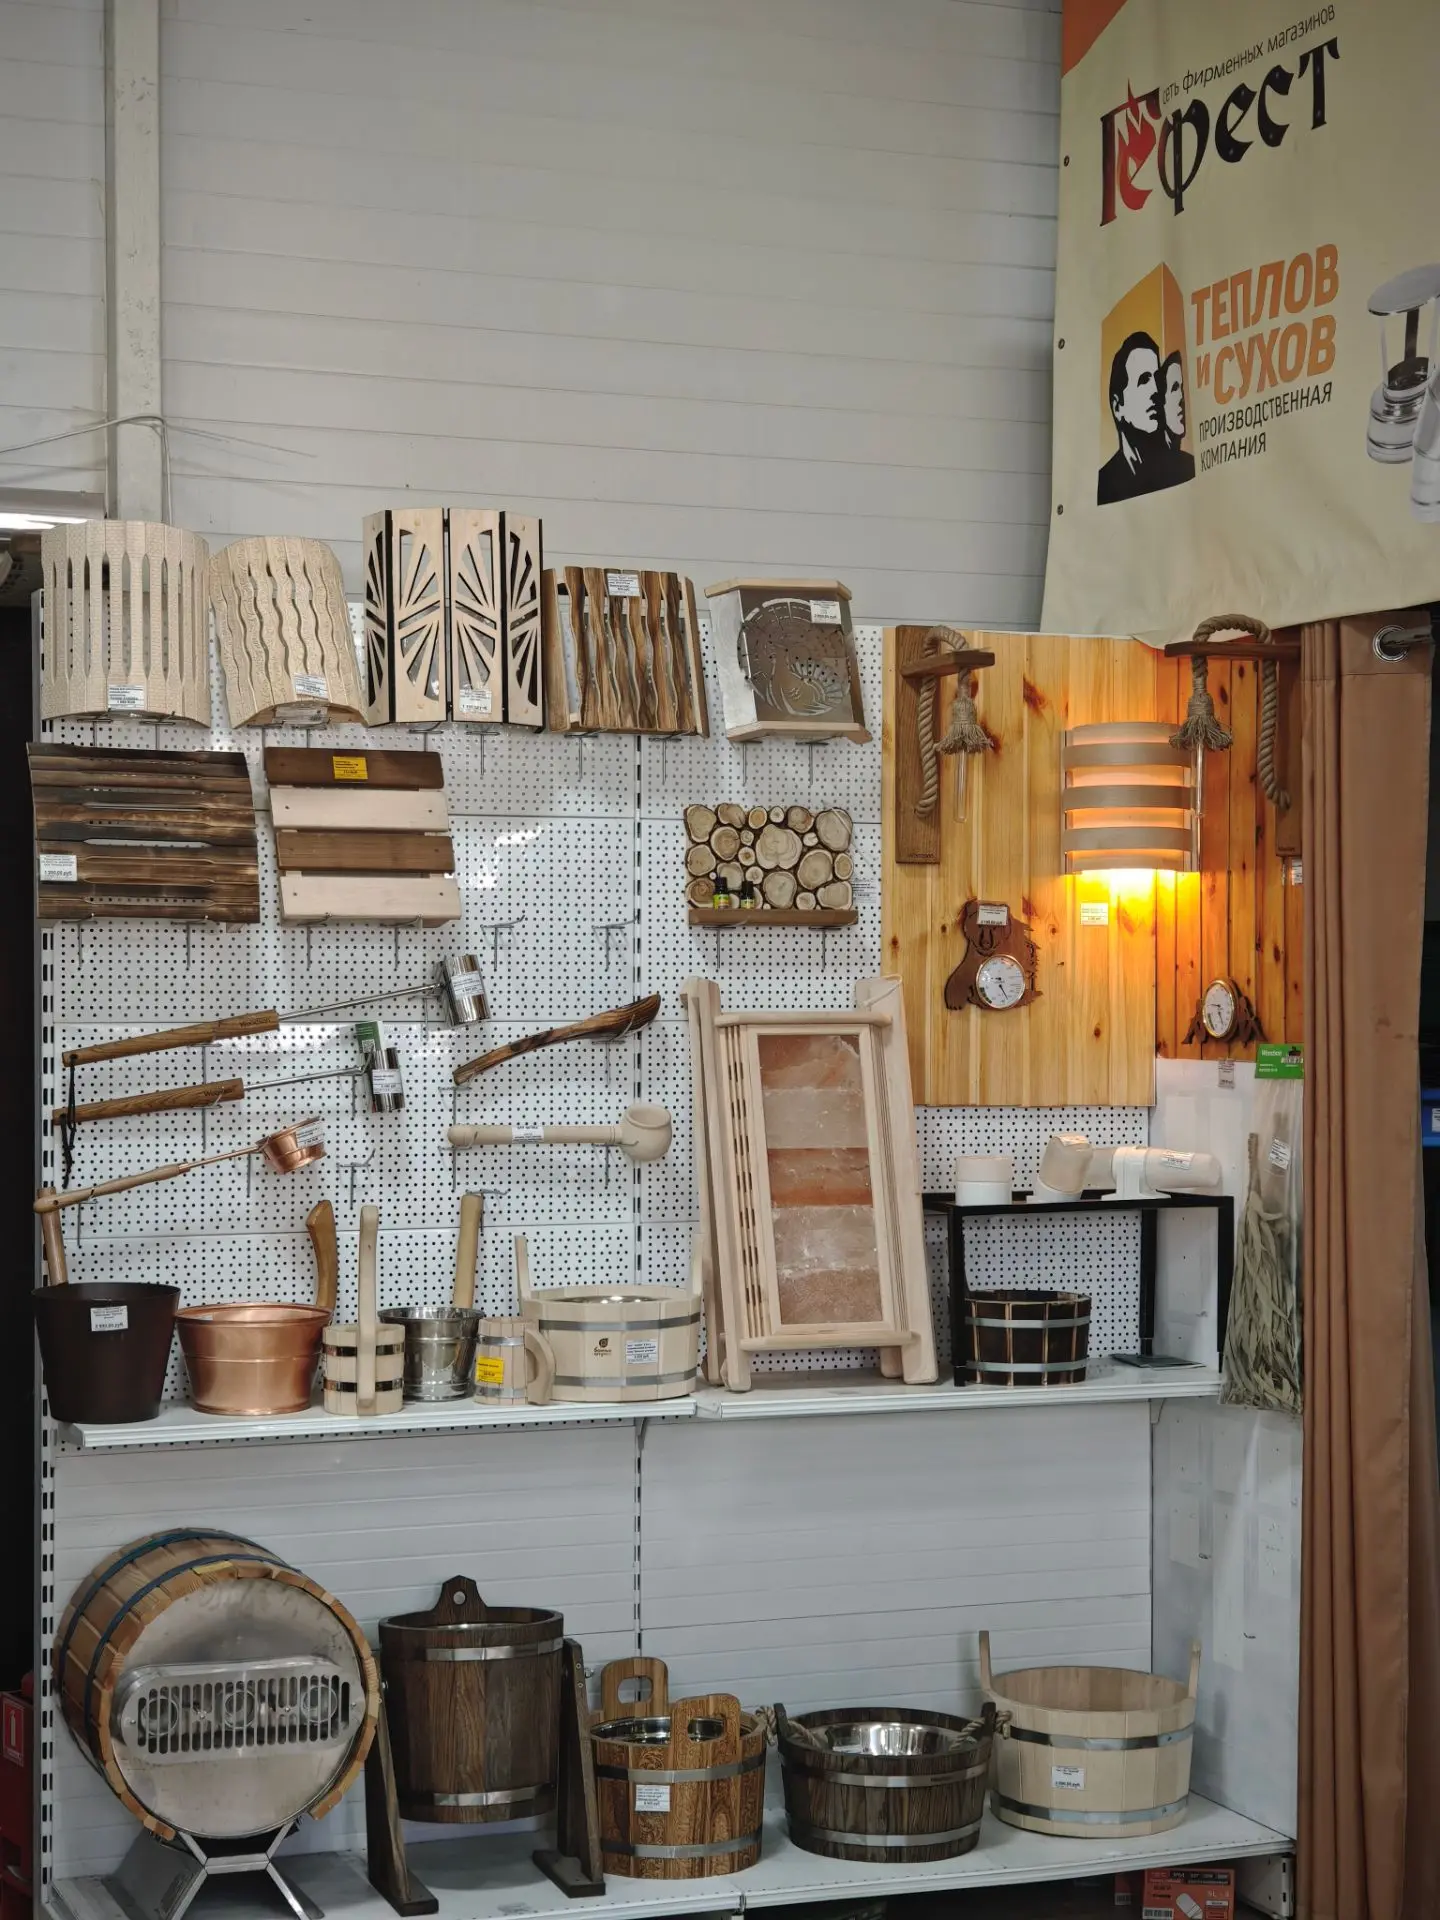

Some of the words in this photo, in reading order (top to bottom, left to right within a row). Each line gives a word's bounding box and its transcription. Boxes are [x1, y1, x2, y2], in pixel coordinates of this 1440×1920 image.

[1182, 43, 1264, 94] фирменных
[1267, 5, 1336, 54] магазинов
[1191, 243, 1340, 346] ТЕПЛОВ
[1213, 314, 1338, 406] СУХОВ
[1199, 381, 1333, 443] ПРОИЗВОДСТВЕННАЯ
[1200, 432, 1267, 472] КОМПАНИЯ
